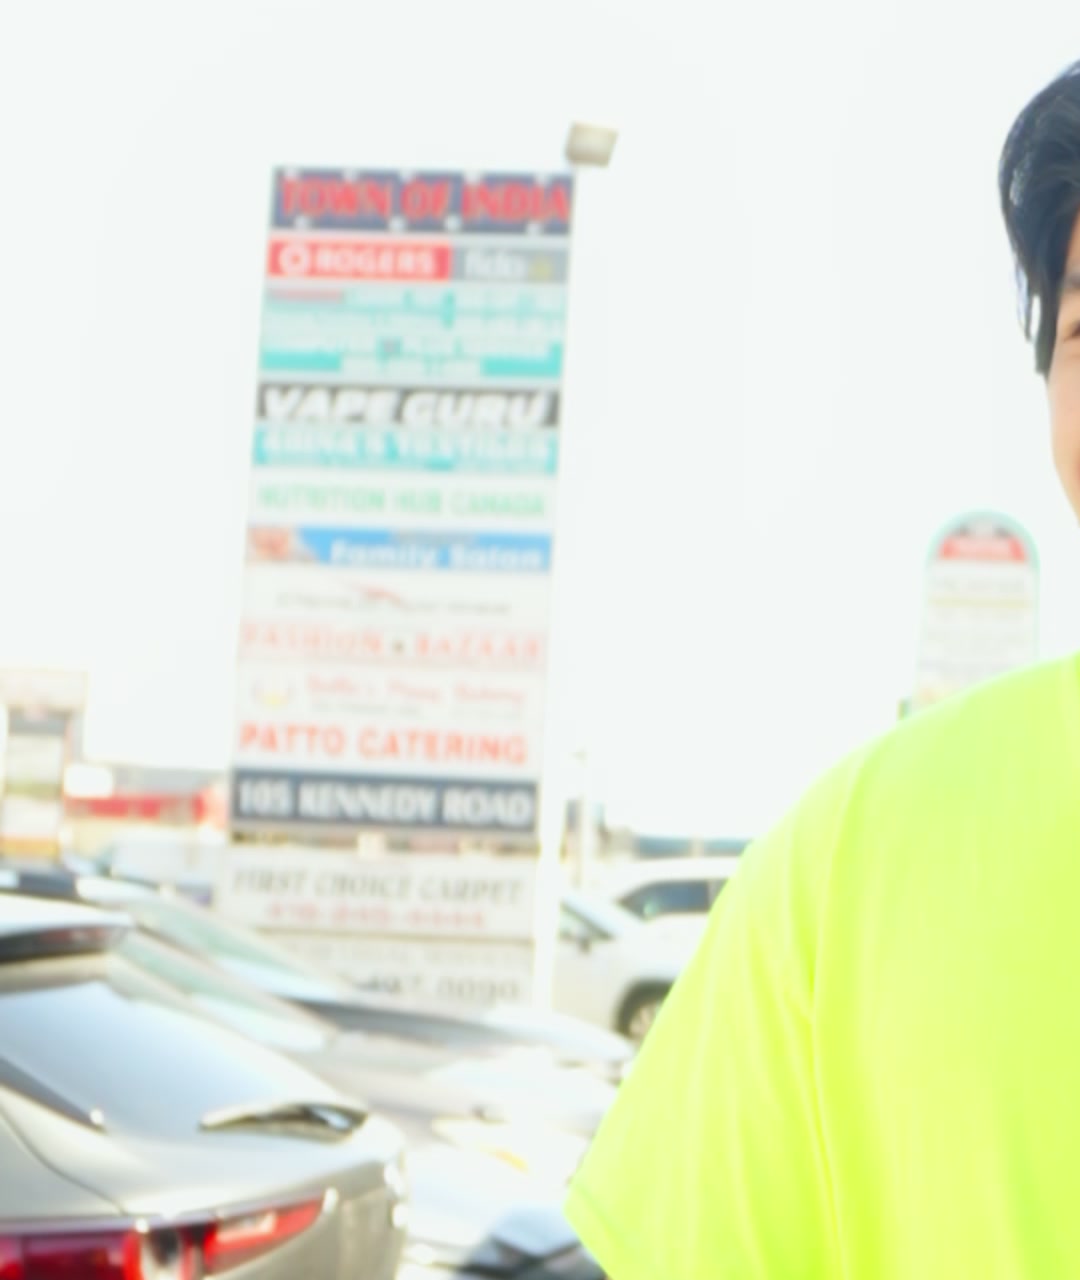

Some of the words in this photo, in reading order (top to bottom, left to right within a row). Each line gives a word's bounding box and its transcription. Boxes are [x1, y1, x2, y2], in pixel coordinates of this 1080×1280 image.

[281, 178, 392, 218] TOWN
[401, 180, 453, 220] OF
[462, 183, 570, 224] INDIA
[315, 244, 436, 276] ROGERS
[263, 387, 402, 423] VAPE
[402, 391, 548, 428] GURU
[329, 538, 440, 569] Family
[448, 541, 544, 568] Salon
[240, 723, 346, 756] PATTO
[358, 728, 528, 765] CATERING
[301, 782, 437, 822] KENNEDY
[444, 788, 534, 826] ROAD
